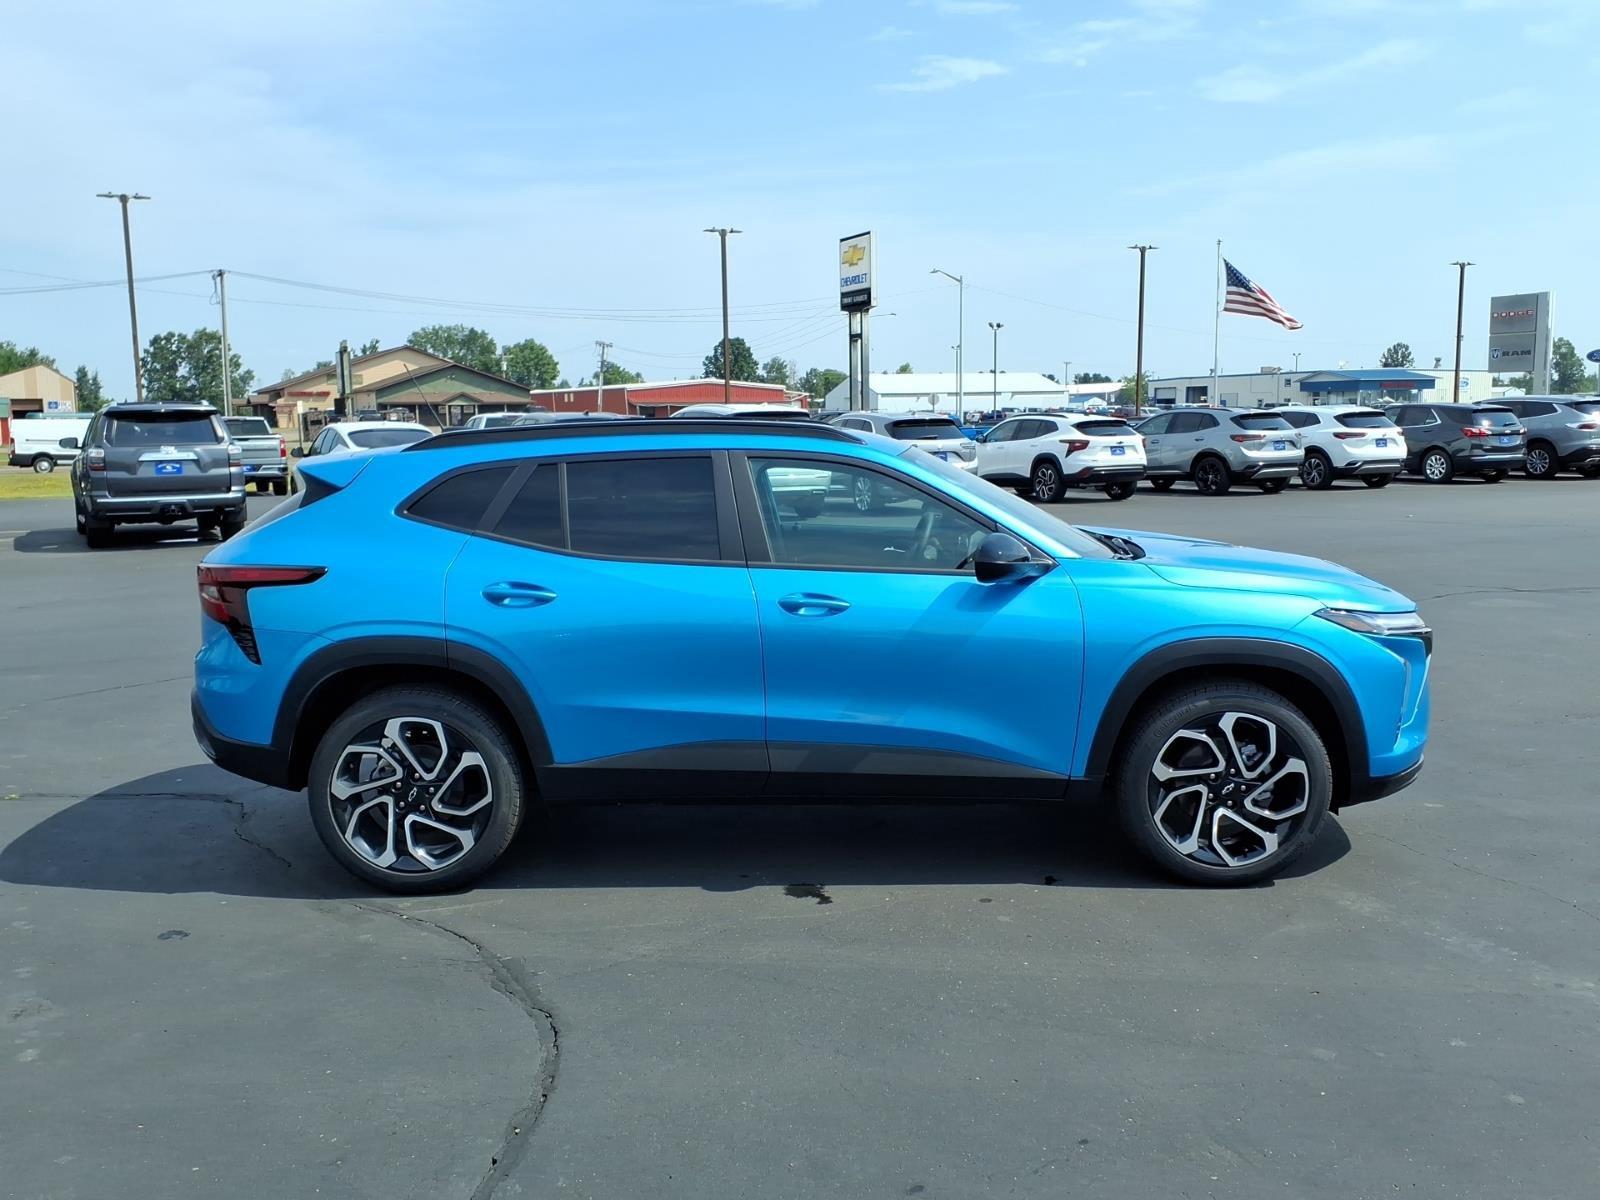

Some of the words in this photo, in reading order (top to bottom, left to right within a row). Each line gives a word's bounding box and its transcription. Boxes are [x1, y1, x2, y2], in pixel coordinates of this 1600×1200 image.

[840, 273, 867, 287] CHEVROLET
[1492, 309, 1535, 318] DODGE
[1502, 349, 1532, 357] RAM
